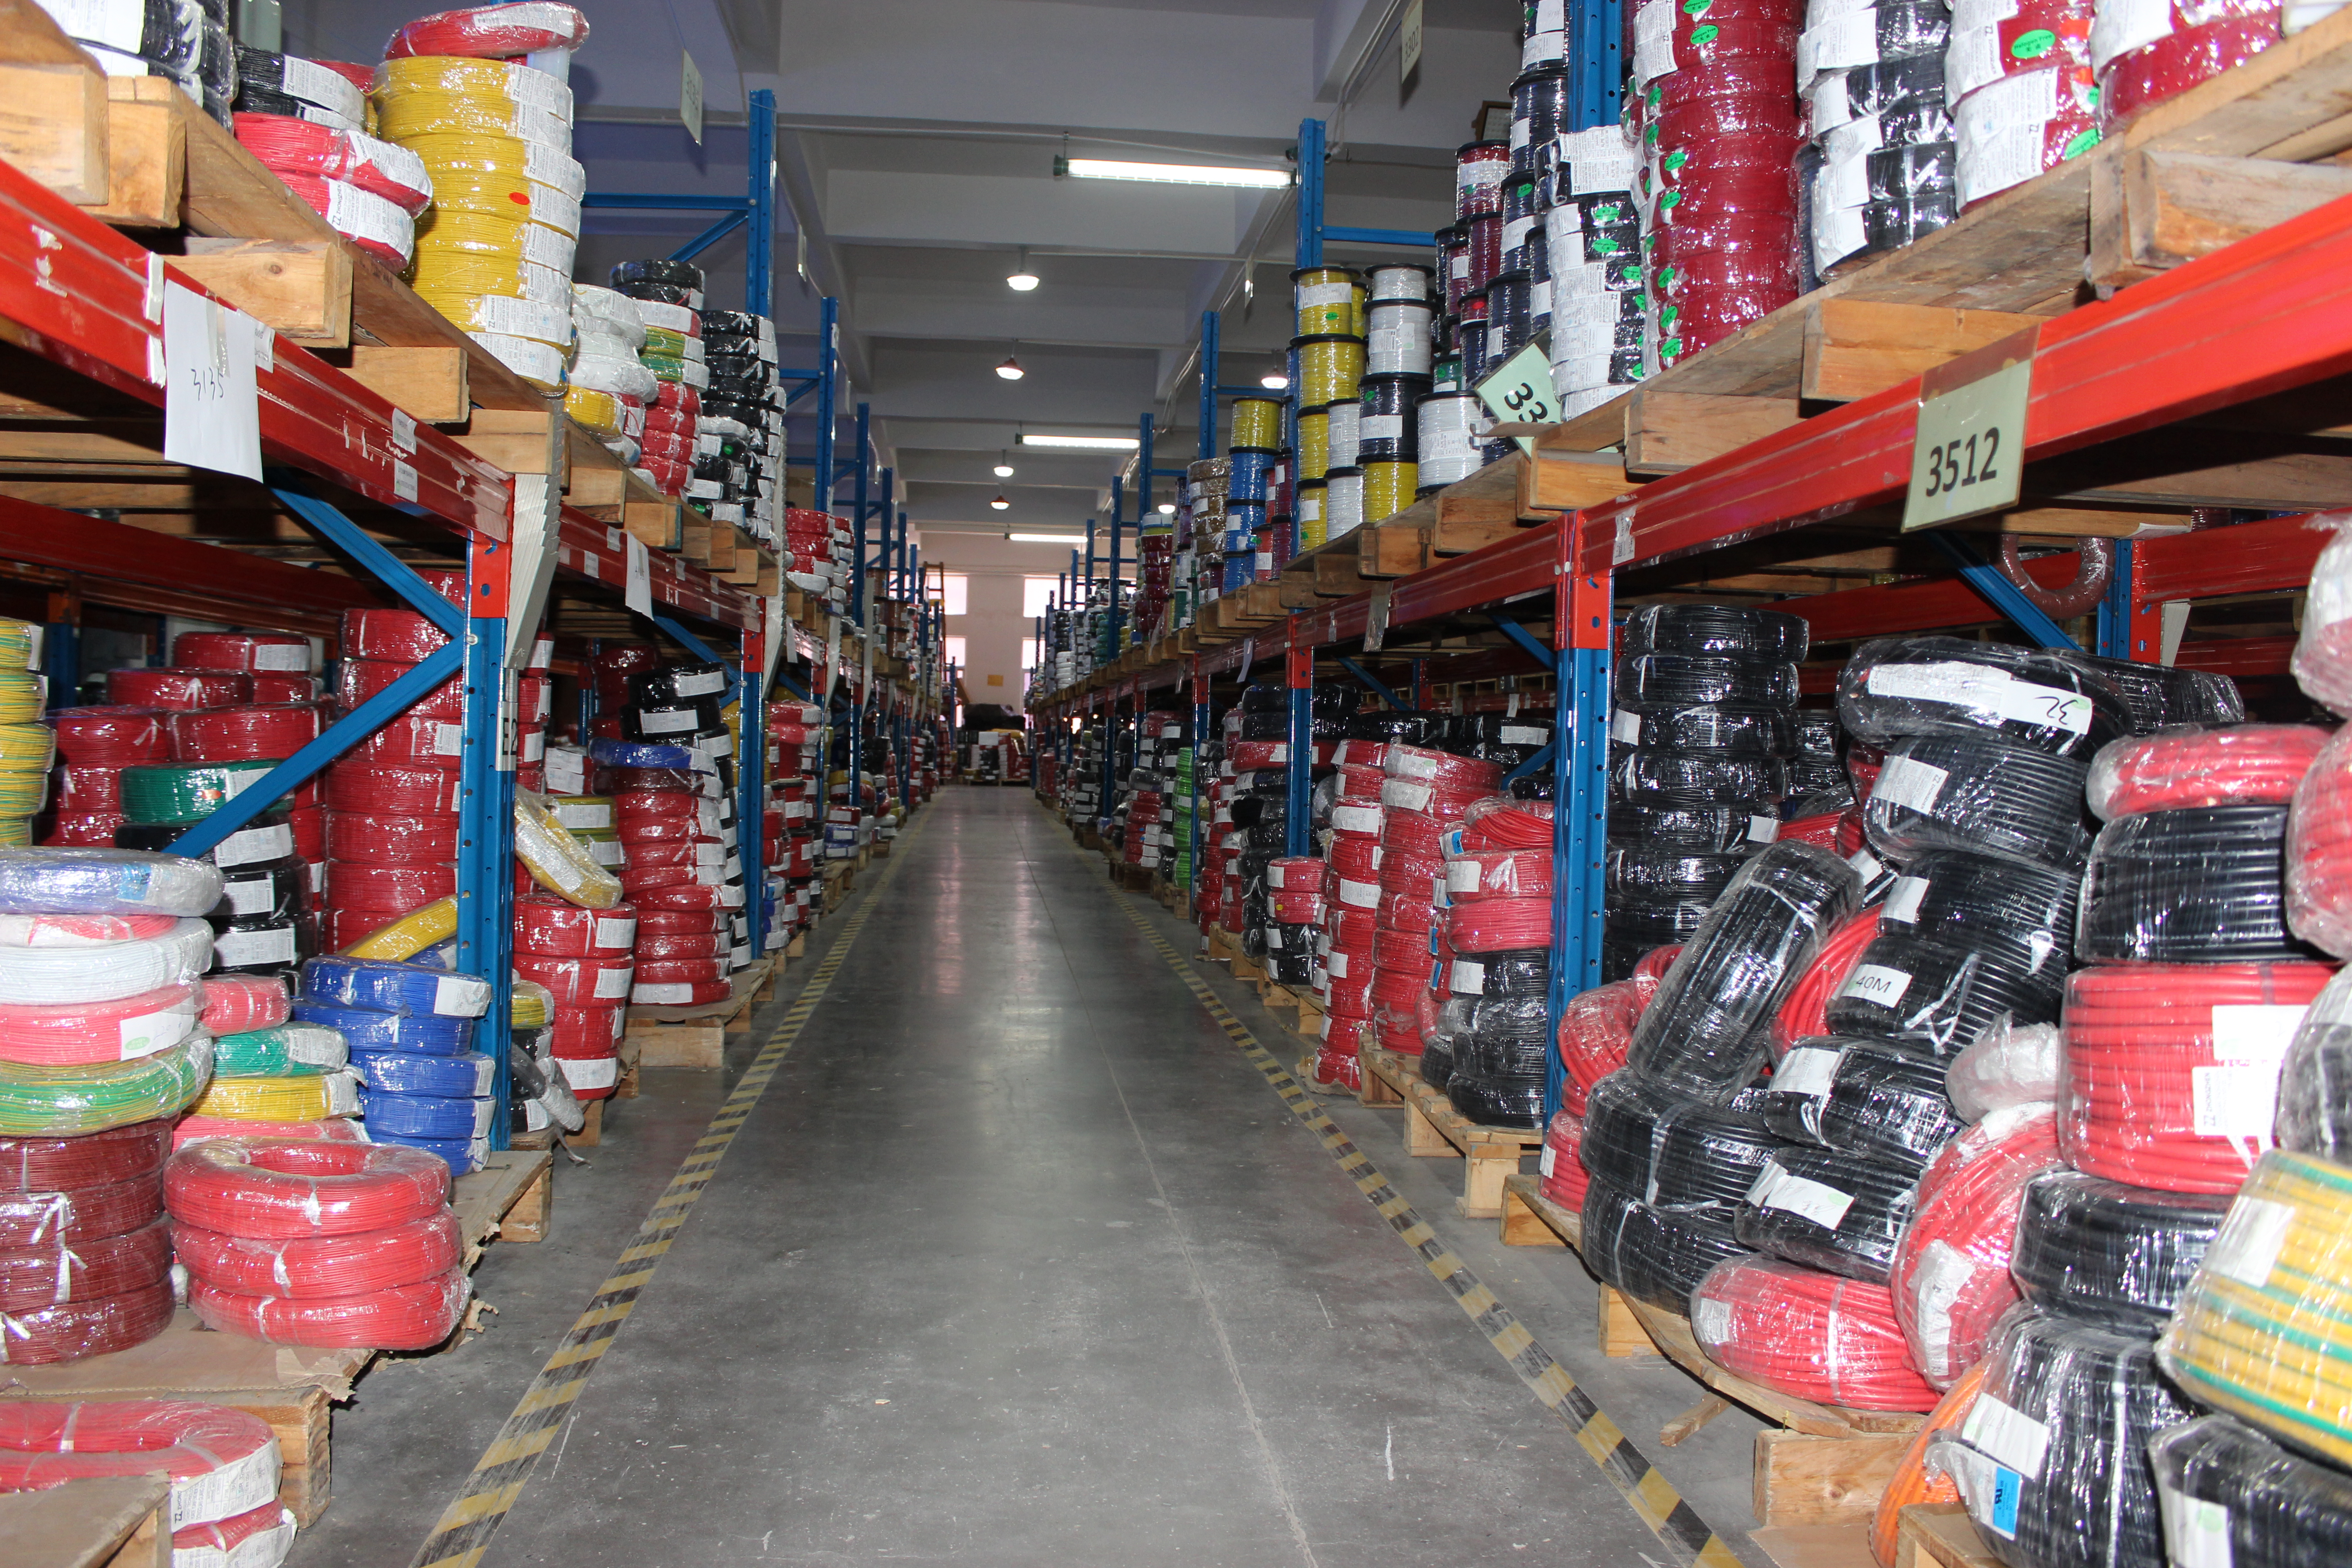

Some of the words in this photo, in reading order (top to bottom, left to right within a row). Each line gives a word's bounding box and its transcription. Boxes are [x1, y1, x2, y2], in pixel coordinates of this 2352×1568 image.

[1691, 31, 1707, 40] Halogen
[332, 215, 341, 226] ZZ
[191, 366, 224, 401] 3135
[1926, 426, 2000, 497] 3512
[1932, 774, 1942, 784] ZZ
[1856, 975, 1892, 993] 40M
[2203, 1115, 2217, 1127] ZZ
